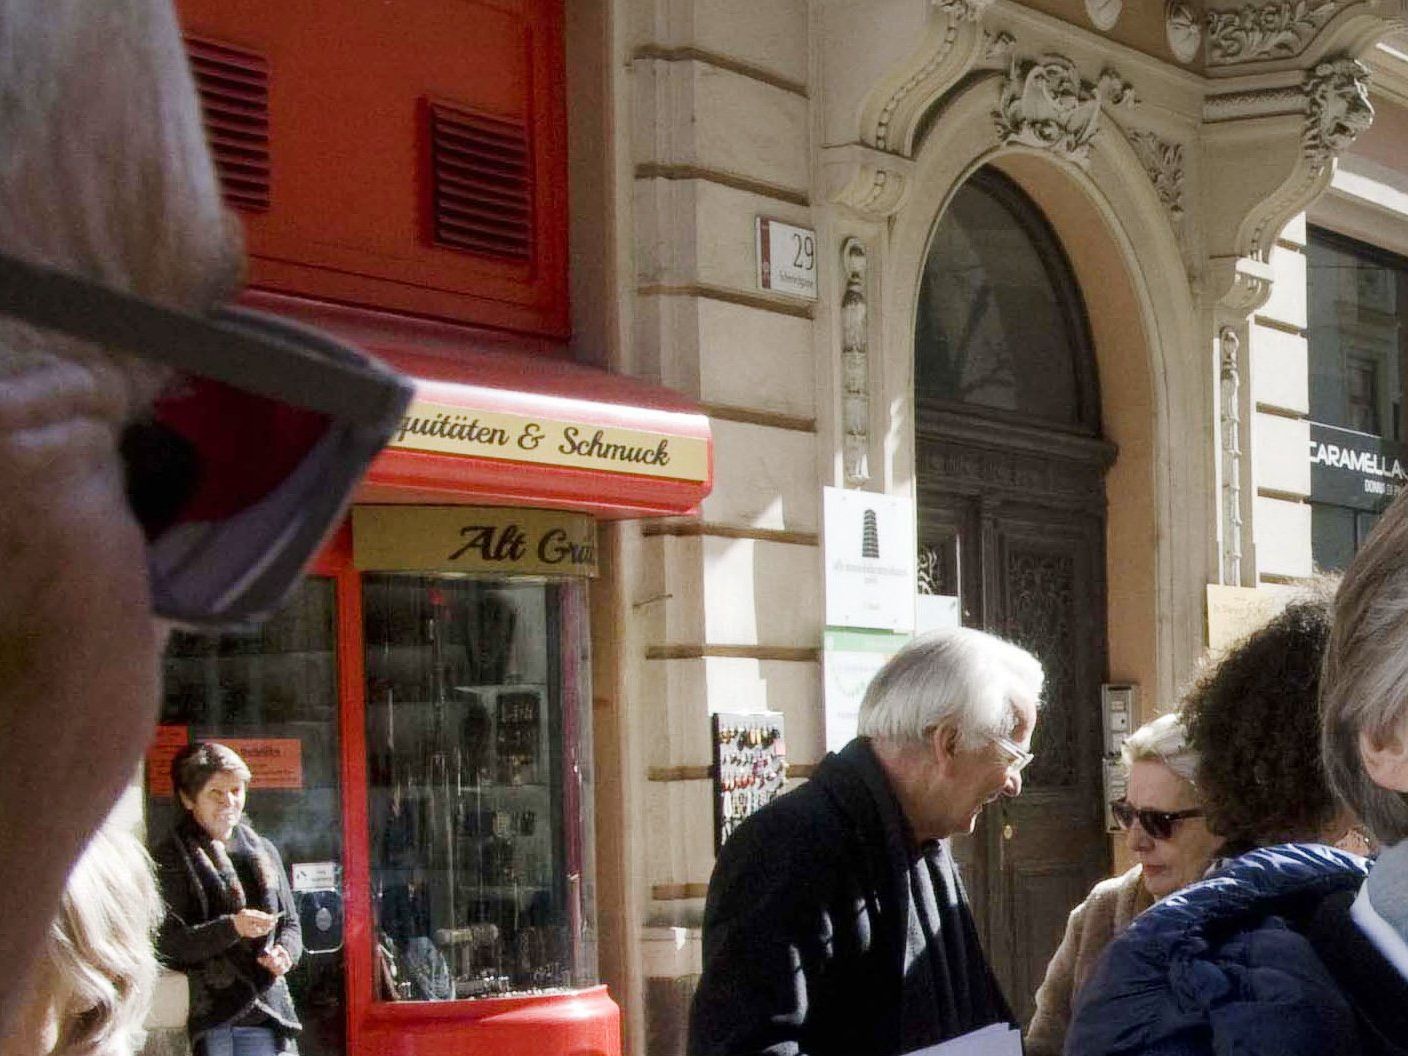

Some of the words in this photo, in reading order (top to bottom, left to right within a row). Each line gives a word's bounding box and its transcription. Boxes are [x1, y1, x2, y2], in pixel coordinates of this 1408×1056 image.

[793, 233, 814, 271] 29
[517, 422, 545, 450] &
[558, 426, 670, 466] Schmuck
[447, 525, 528, 563] Alt
